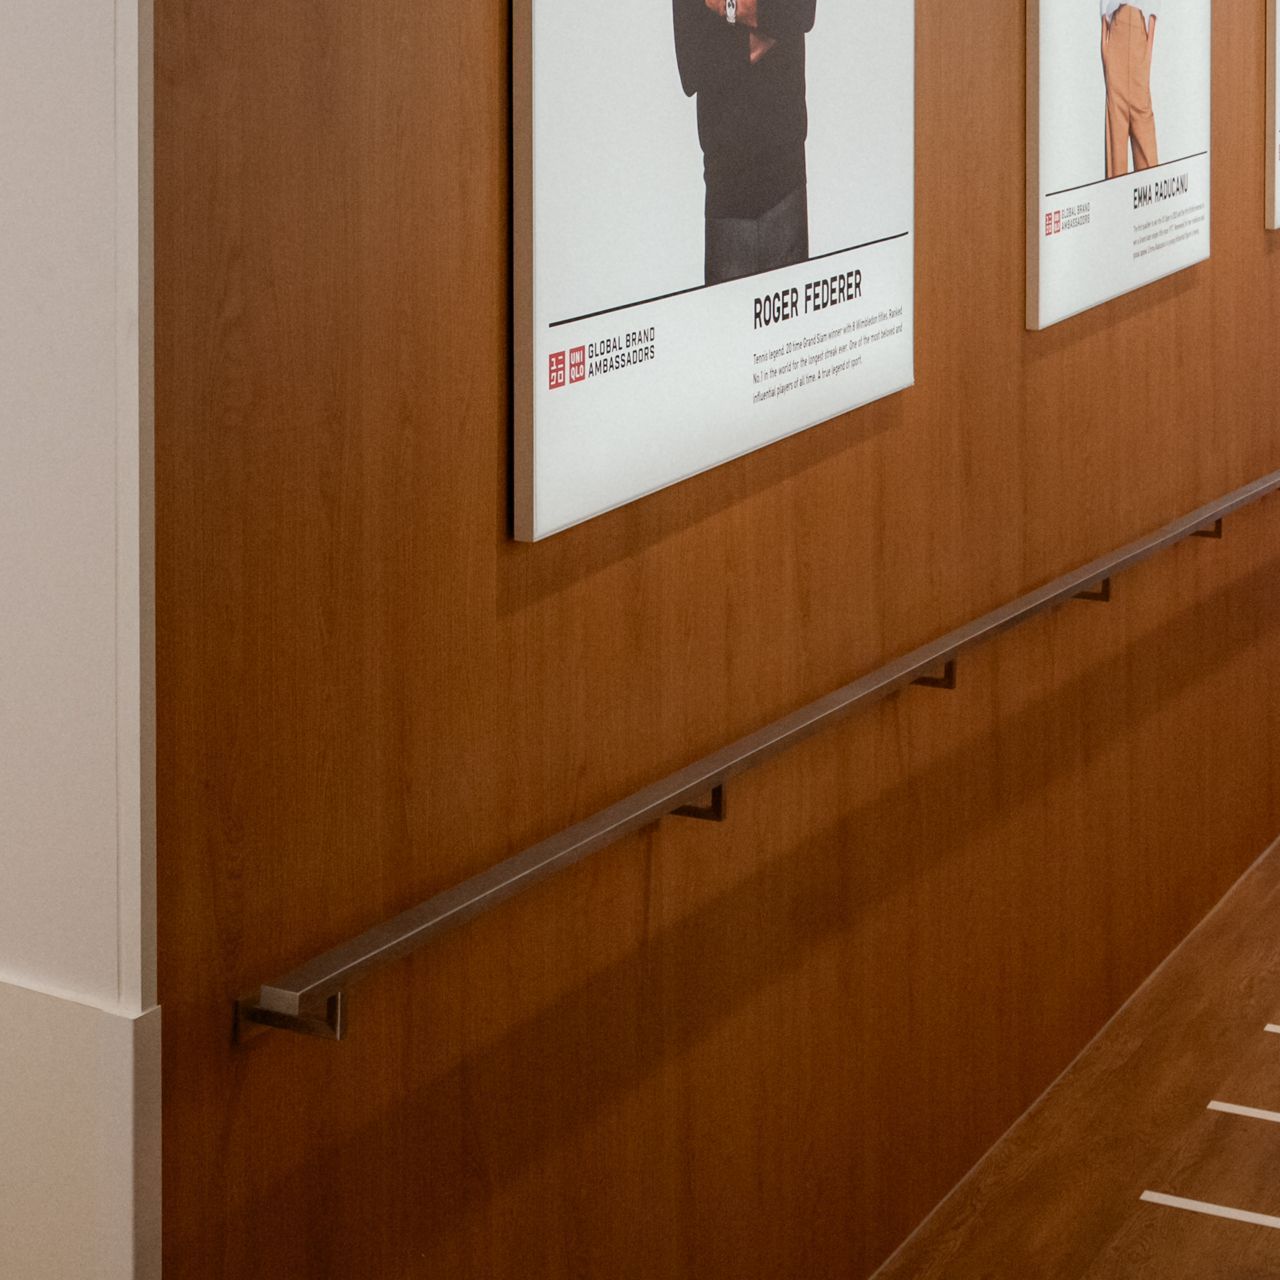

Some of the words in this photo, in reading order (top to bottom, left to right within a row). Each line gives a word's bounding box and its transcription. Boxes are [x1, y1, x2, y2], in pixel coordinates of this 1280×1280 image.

[1133, 185, 1153, 210] EMMA
[1154, 175, 1189, 204] RADUCANU
[753, 287, 799, 330] ROGER
[804, 269, 862, 314] FEDERER
[588, 336, 622, 359] GLOBAL
[625, 327, 655, 348] BRAND
[588, 345, 655, 378] AMBASSADORS
